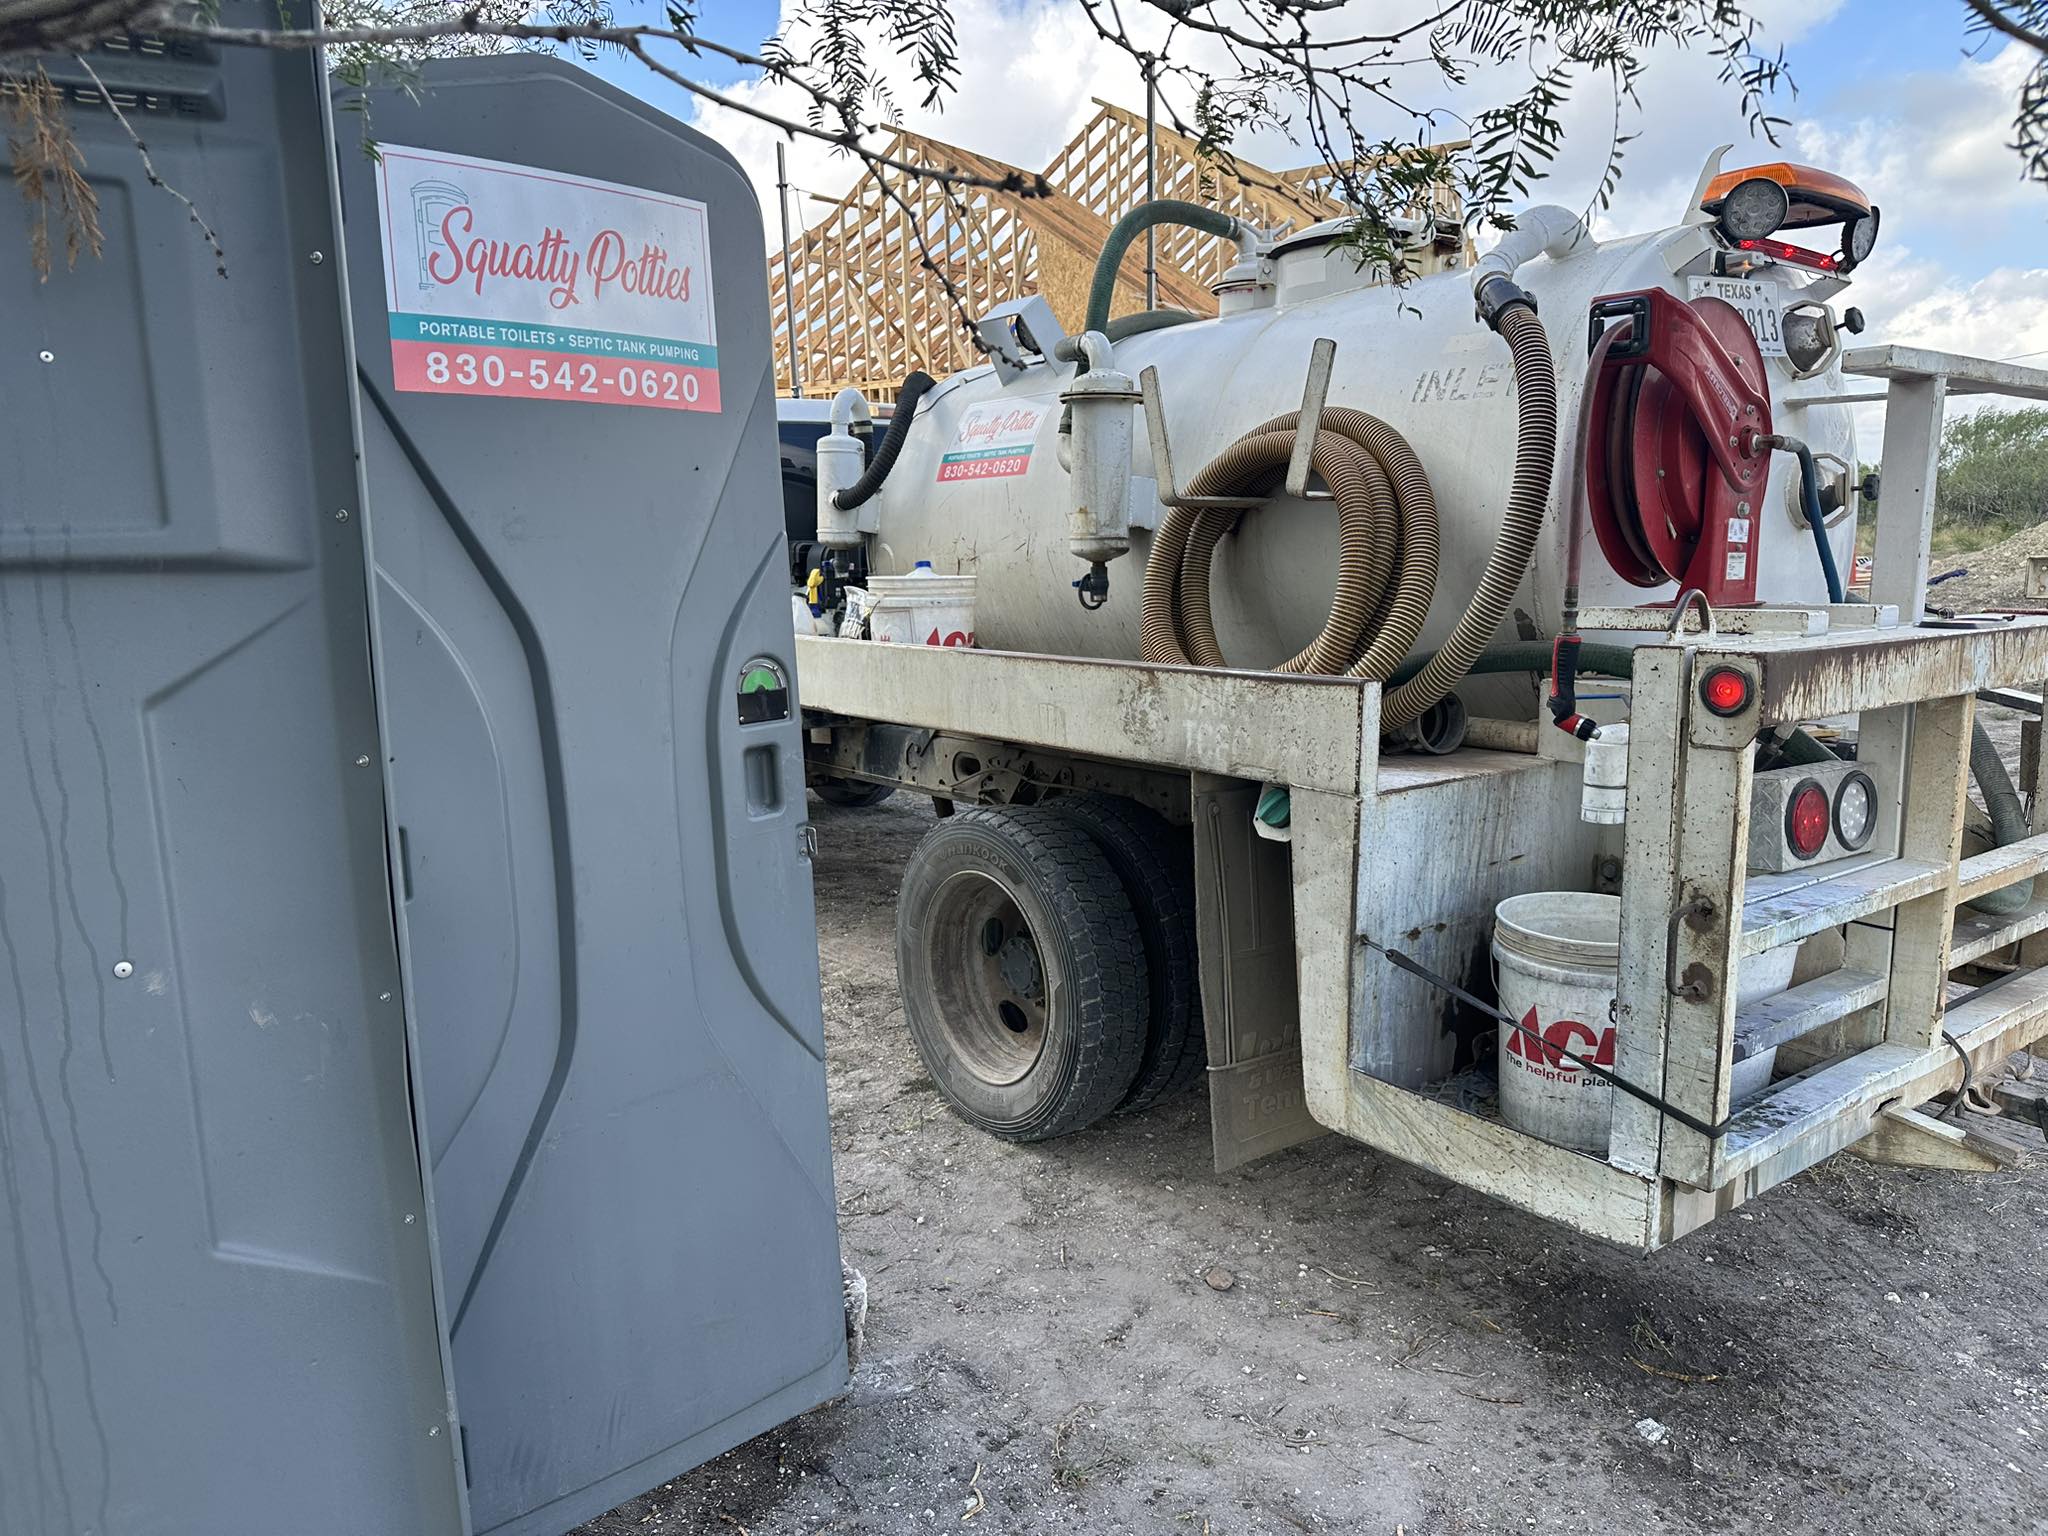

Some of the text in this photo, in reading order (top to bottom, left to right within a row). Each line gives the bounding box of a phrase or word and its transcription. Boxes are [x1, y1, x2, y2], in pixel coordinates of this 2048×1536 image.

[428, 206, 691, 309] Squatty Potties
[1717, 283, 1752, 300] TEXAS
[419, 321, 699, 361] PORTABLE TOILETS SEPTIC TANK PUMPING
[1738, 307, 1779, 342] 813
[426, 351, 699, 402] 830-542-0620
[944, 458, 1021, 479] 830-542-0620
[1506, 1051, 1523, 1068] The
[1526, 1060, 1577, 1084] helpful
